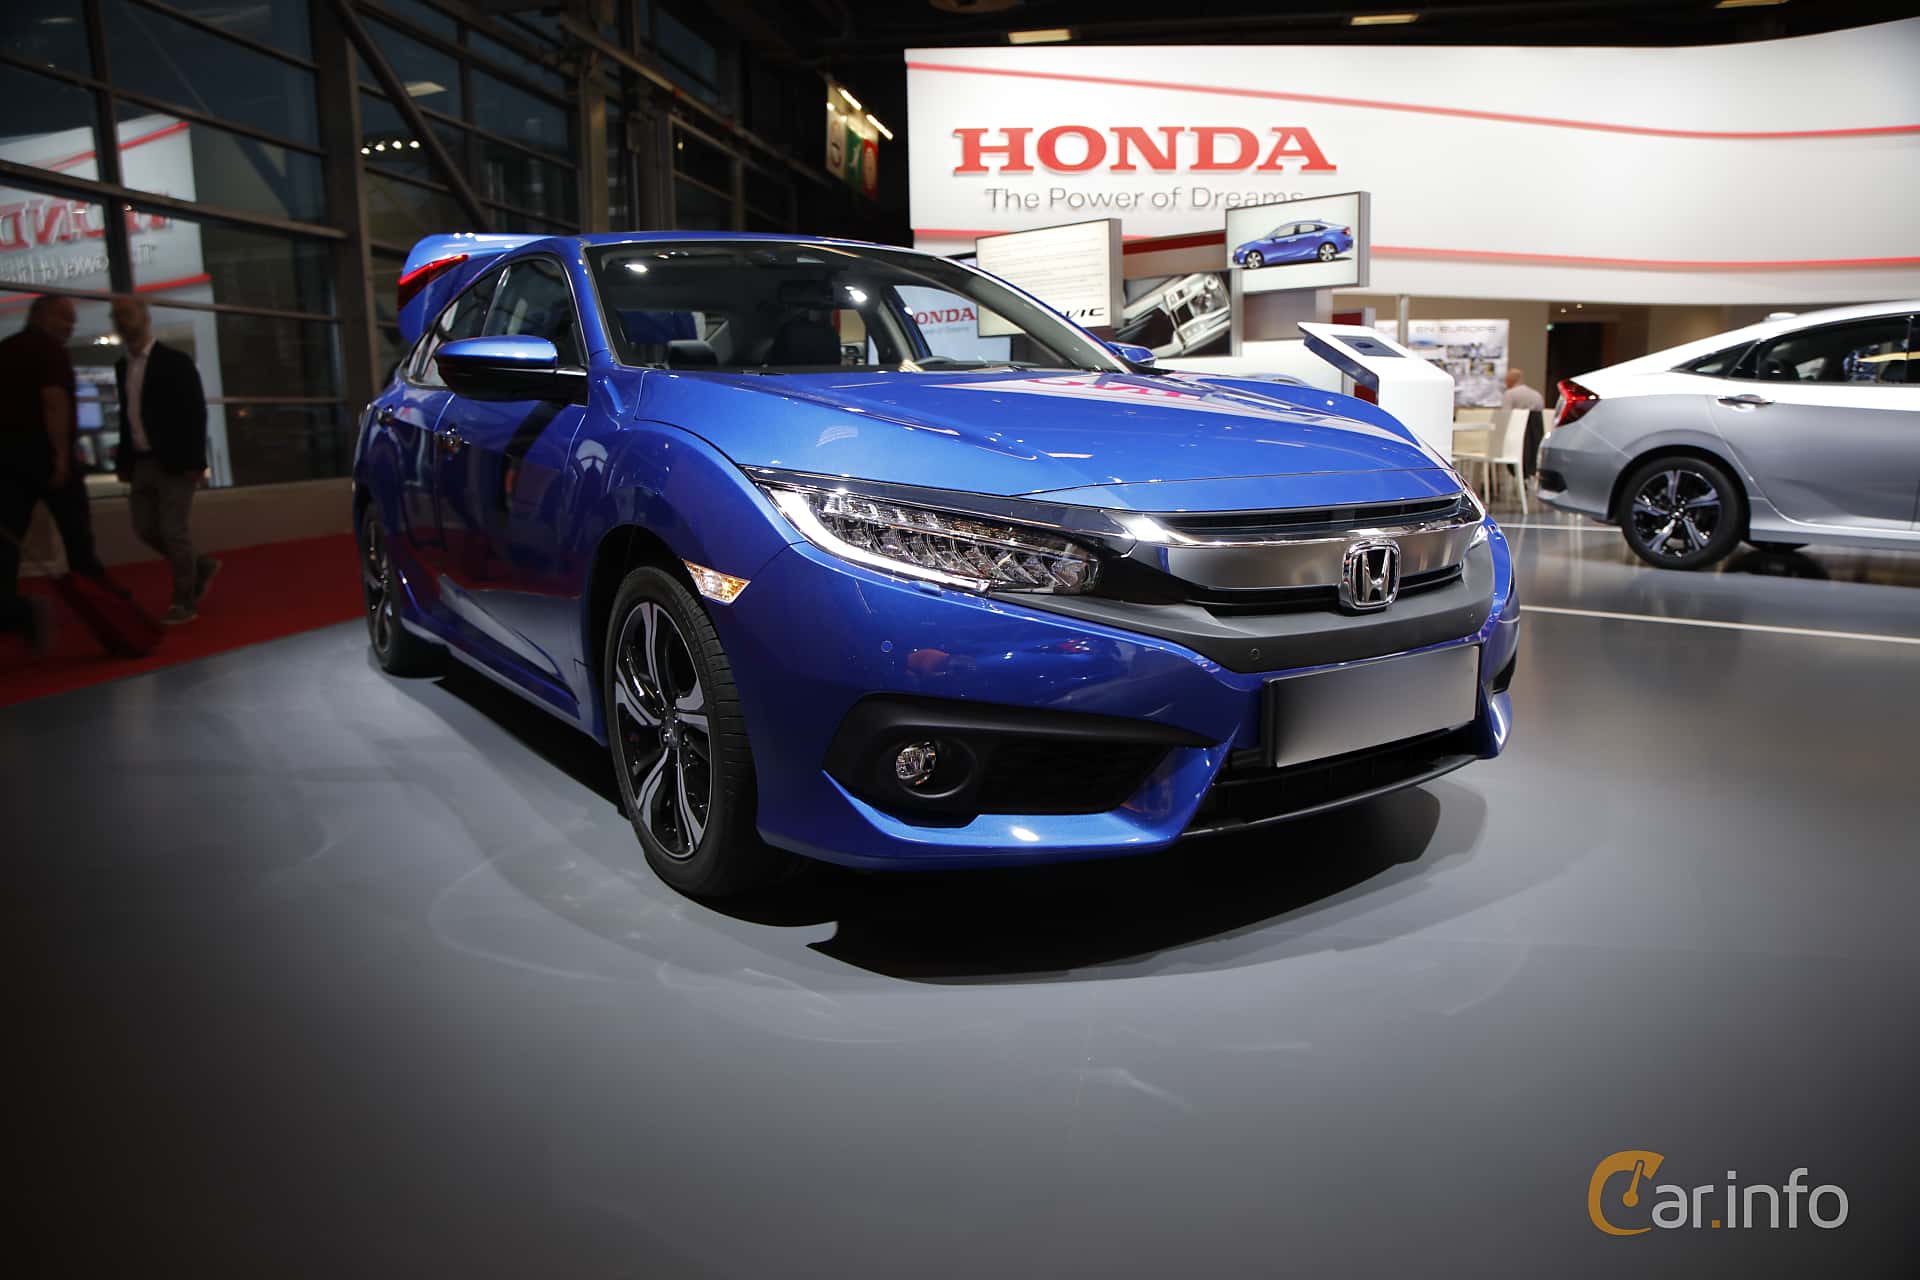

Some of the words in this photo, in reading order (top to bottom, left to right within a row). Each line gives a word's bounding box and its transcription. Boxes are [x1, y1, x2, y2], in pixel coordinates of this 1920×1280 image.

[953, 124, 1337, 173] HONDA
[985, 187, 1040, 209] The
[1048, 187, 1145, 209] Power
[1151, 186, 1182, 208] of
[912, 307, 976, 325] ONDA
[1065, 307, 1104, 318] VIC
